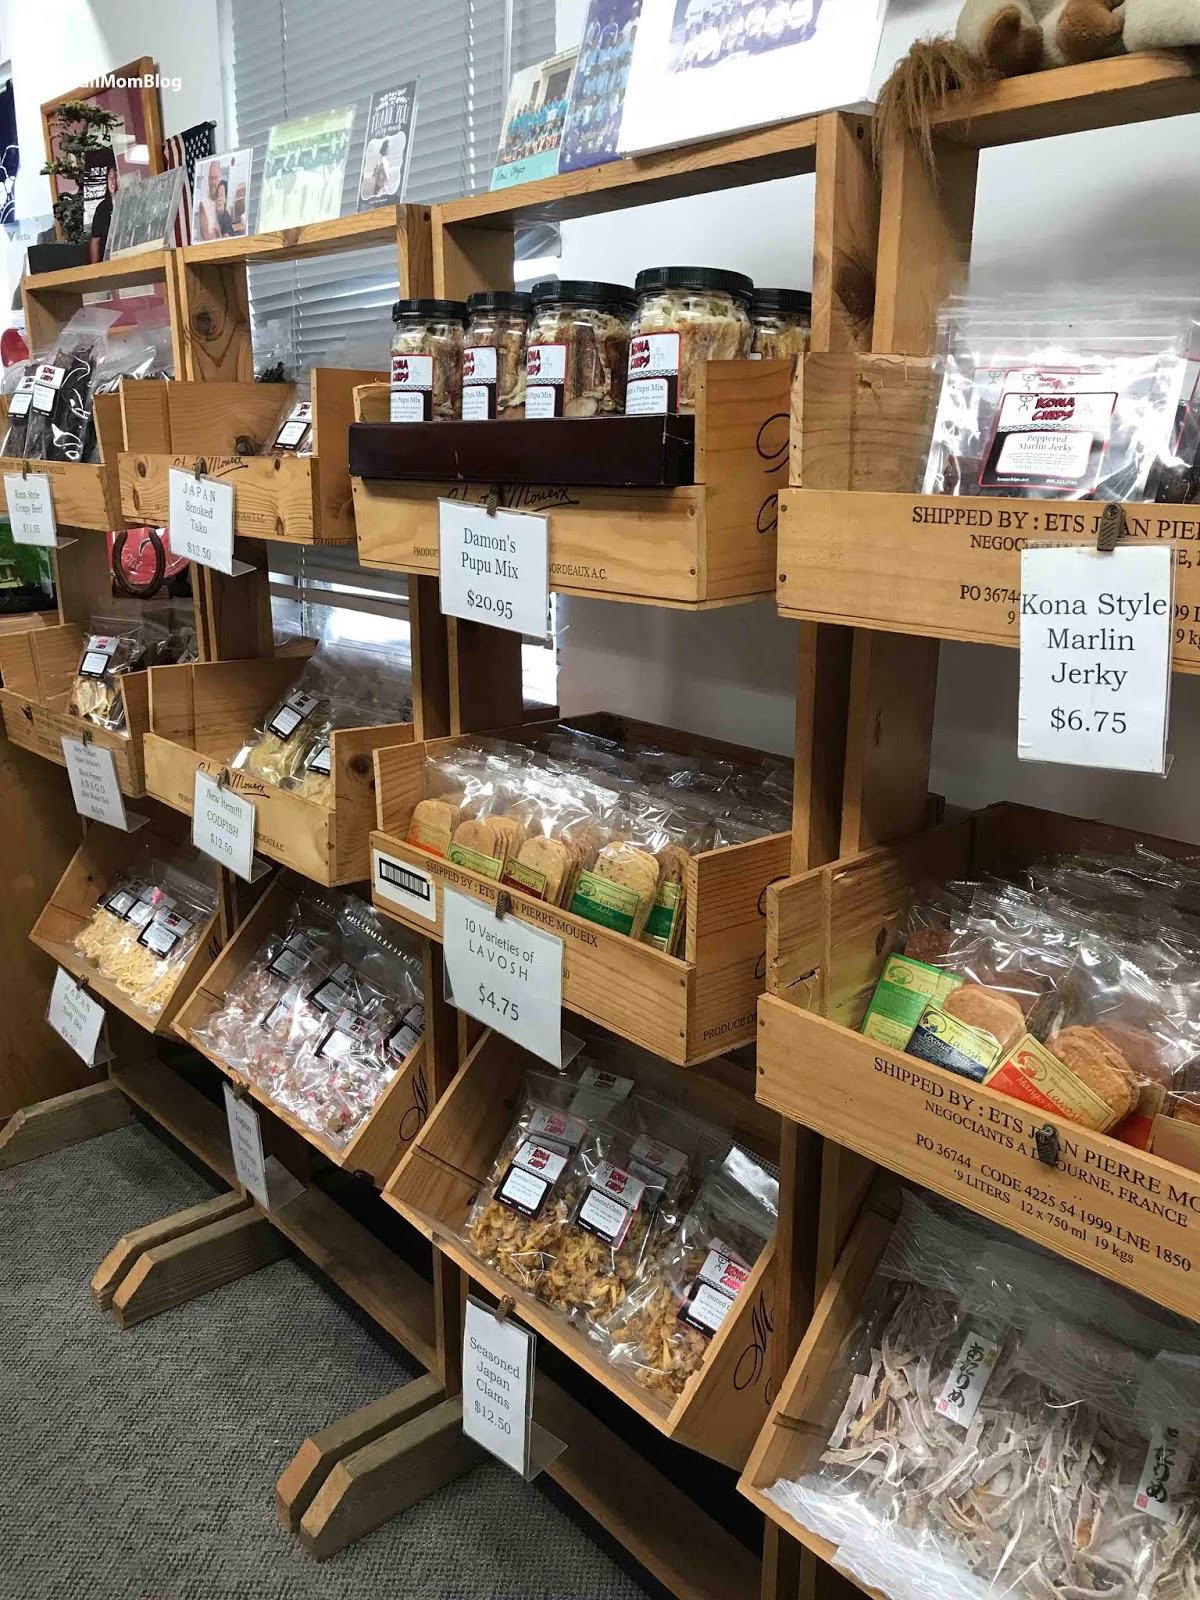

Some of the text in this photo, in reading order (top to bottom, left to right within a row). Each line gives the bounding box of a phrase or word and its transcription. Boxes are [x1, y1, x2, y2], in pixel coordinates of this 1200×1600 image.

[410, 395, 421, 403] Mix
[651, 383, 664, 392] Mix
[1018, 443, 1073, 452] Marlin Jerky
[1026, 434, 1068, 446] Peppered
[185, 500, 214, 520] Smoked
[912, 506, 993, 527] SHIPPED
[997, 510, 1030, 530] BY
[1044, 512, 1085, 534] ETS
[190, 518, 208, 535] Tako
[463, 527, 517, 554] Damon's
[186, 541, 212, 561] $12.50
[461, 551, 520, 580] Pupu Mix
[466, 588, 513, 620] $20.95
[960, 584, 982, 602] PO
[1021, 592, 1168, 622] Kona Style
[1046, 628, 1136, 651] Marlin
[1051, 662, 1129, 692] Jerky
[1050, 705, 1127, 734] $6.75
[206, 787, 242, 819] New Item!!!
[206, 809, 240, 838] CODFISH
[209, 832, 233, 856] $12.50
[425, 860, 460, 884] SHIPPED
[461, 879, 473, 890] BY
[464, 917, 535, 963] 10 Varieties of
[521, 903, 599, 948] PIERRE MOUEIX
[478, 982, 520, 1021] $4.75
[703, 1016, 747, 1041] PRODUCE
[924, 1032, 952, 1053] Coconut
[948, 1035, 983, 1062] Lavosh
[1015, 1075, 1045, 1104] Mango
[1045, 1087, 1085, 1125] Lavosh
[873, 1056, 944, 1098] SHIPPED
[948, 1088, 976, 1111] BY
[987, 1106, 1023, 1133] ETS
[1084, 1147, 1162, 1195] PIERRE
[924, 1099, 1014, 1149] NEGOCIANTS
[1016, 1142, 1028, 1156] A
[1117, 1185, 1188, 1228] FRANCE
[915, 1132, 1192, 1273] PO 36744 CODE 4225 54 1999 LNE 1850
[966, 1174, 1011, 1204] LITERS
[1020, 1200, 1034, 1216] 12
[1047, 1212, 1069, 1232] 750
[1071, 1226, 1087, 1241] ml
[1094, 1235, 1109, 1251] 19
[1111, 1243, 1134, 1264] kgs
[469, 1336, 521, 1380] Seasoned
[476, 1360, 511, 1392] Japan
[476, 1377, 511, 1410] Clams
[474, 1399, 512, 1436] $12.50
